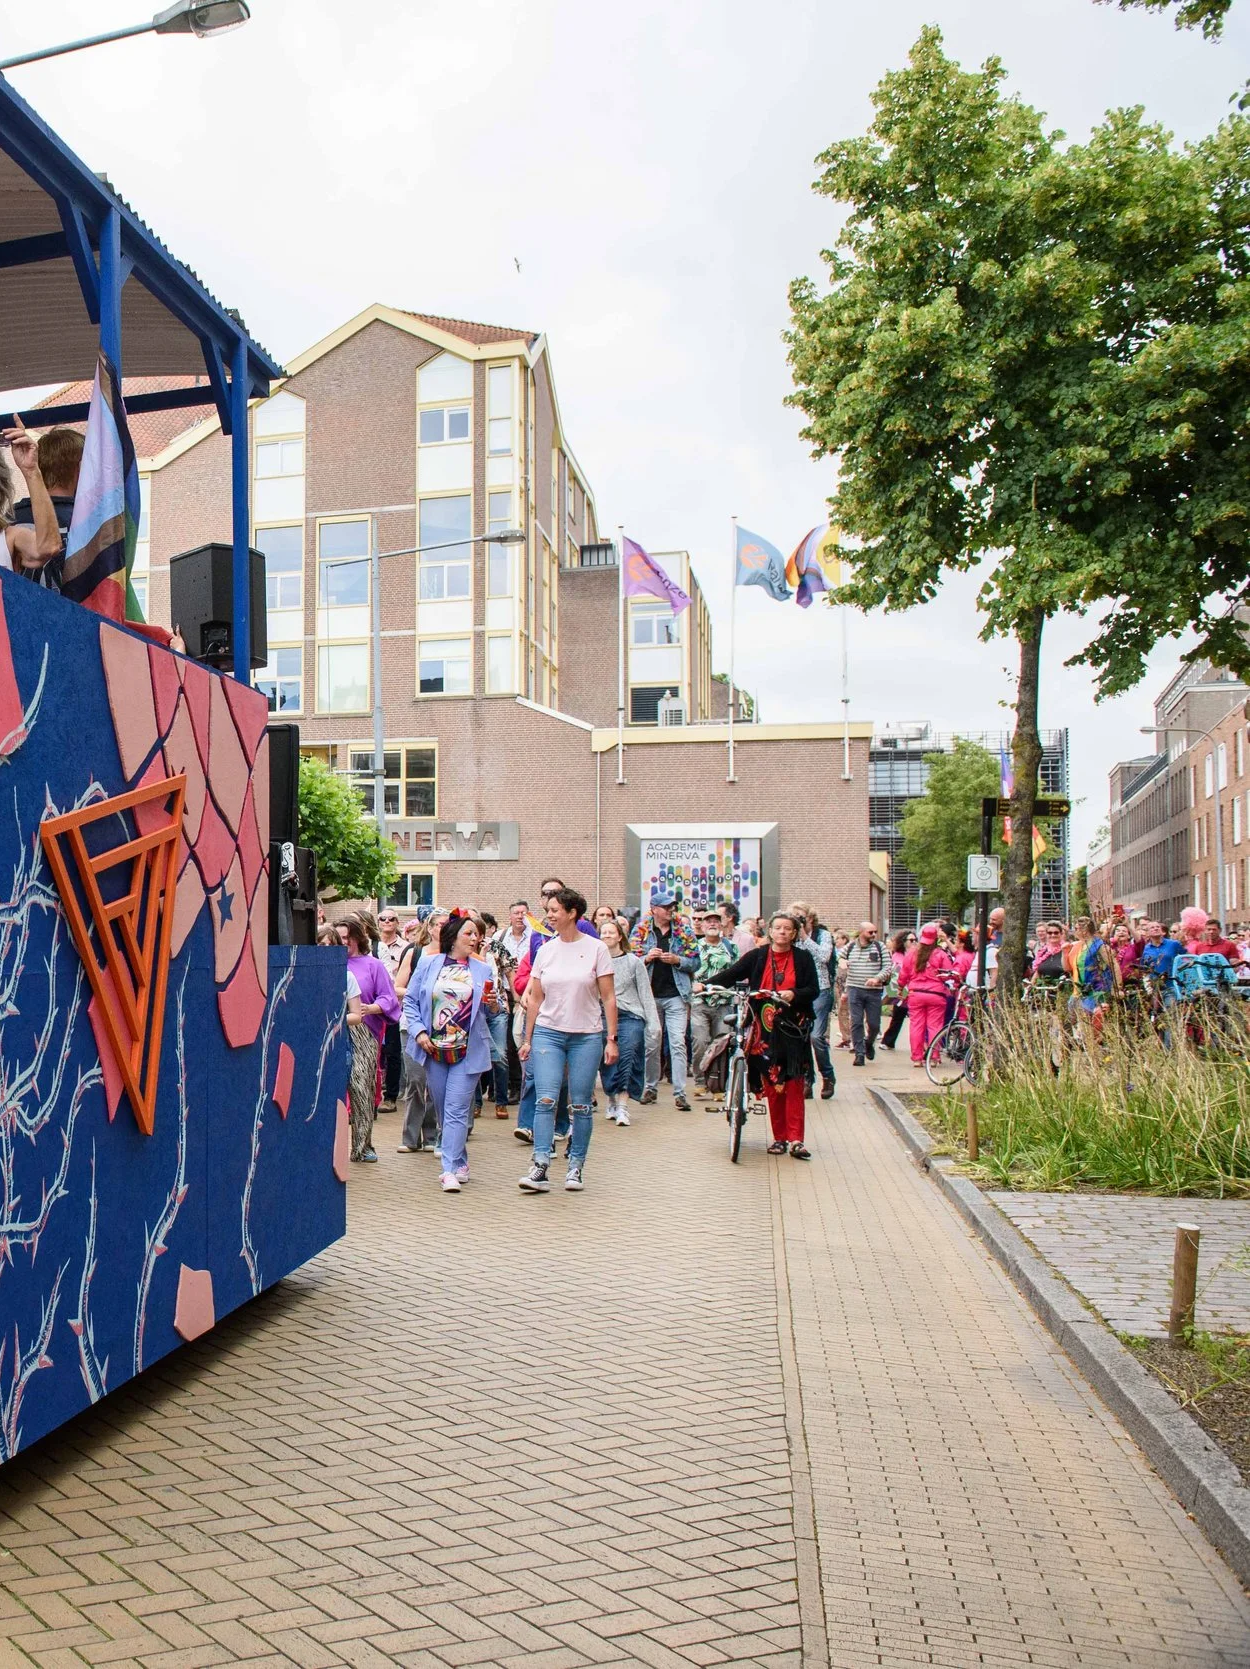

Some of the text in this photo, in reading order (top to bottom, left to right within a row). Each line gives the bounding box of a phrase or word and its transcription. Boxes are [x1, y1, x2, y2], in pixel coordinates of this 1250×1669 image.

[391, 831, 500, 851] NERVA
[646, 843, 707, 851] ACADEMIE
[646, 852, 700, 860] MINERVA
[660, 873, 740, 886] GRADUATION
[684, 899, 715, 908] SHOW
